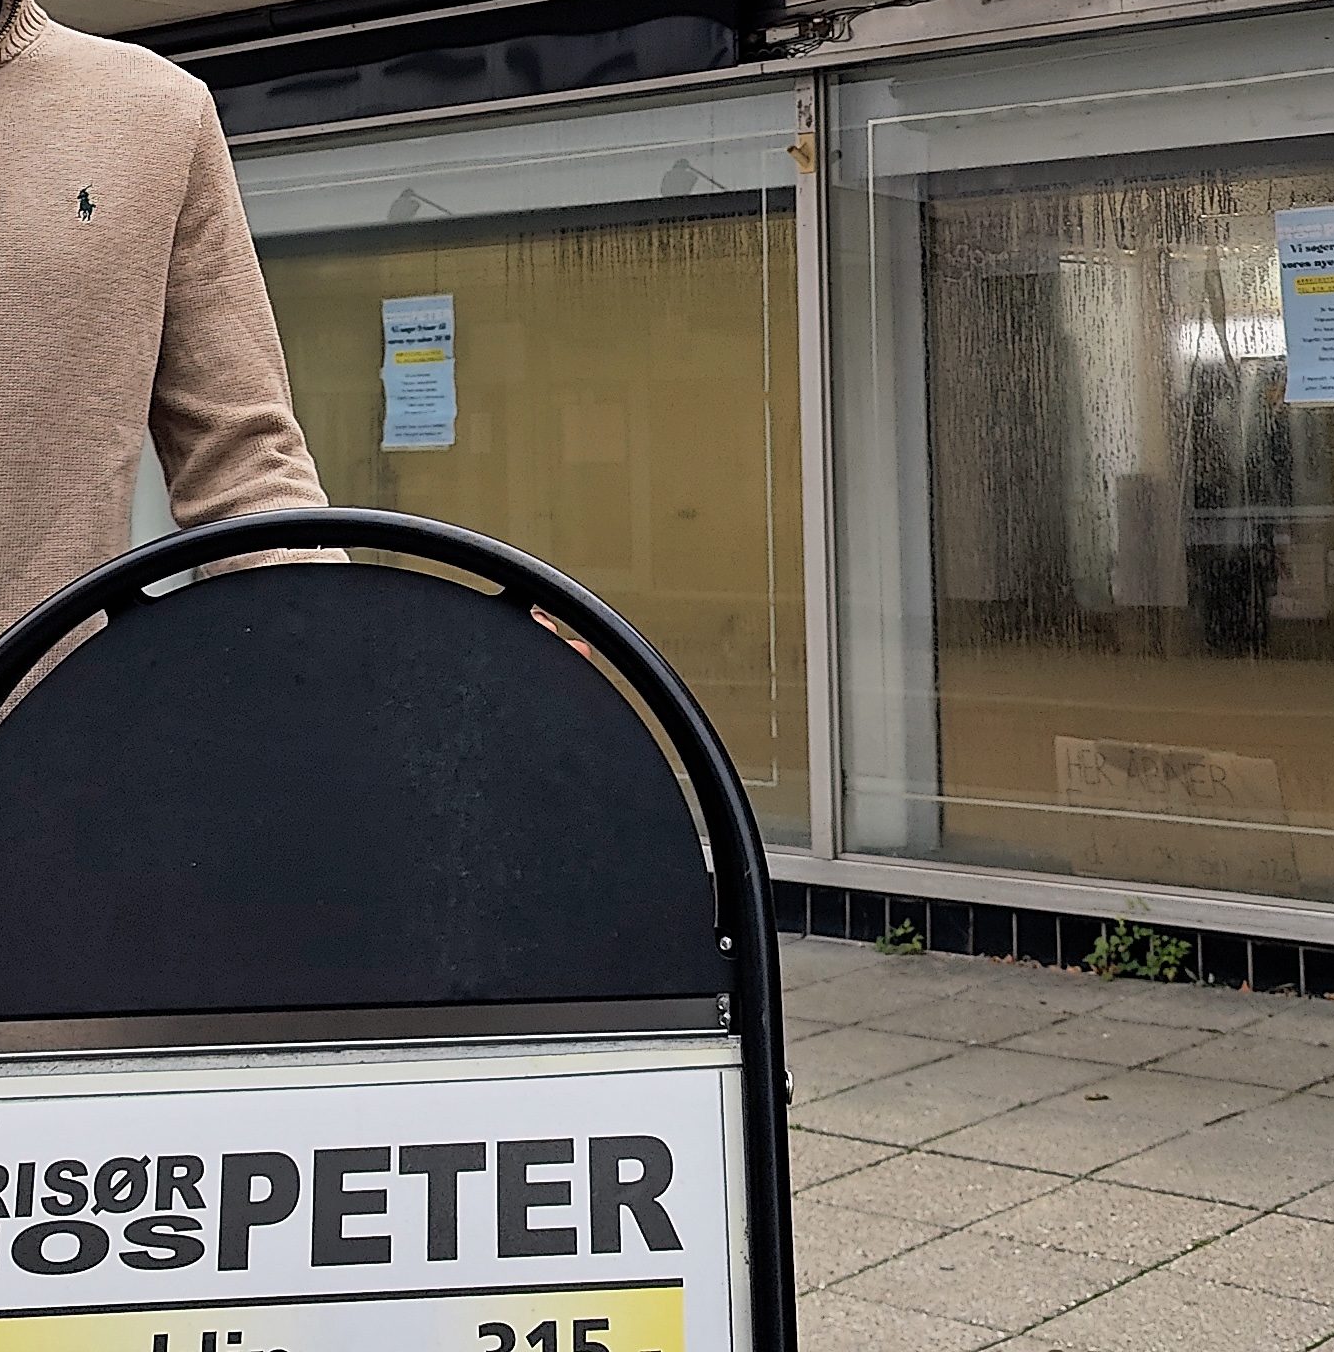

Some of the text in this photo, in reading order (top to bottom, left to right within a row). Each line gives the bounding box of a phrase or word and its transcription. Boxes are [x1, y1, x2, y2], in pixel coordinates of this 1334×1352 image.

[1314, 260, 1334, 269] nye
[1066, 747, 1115, 787] HER
[217, 1135, 684, 1272] PETER
